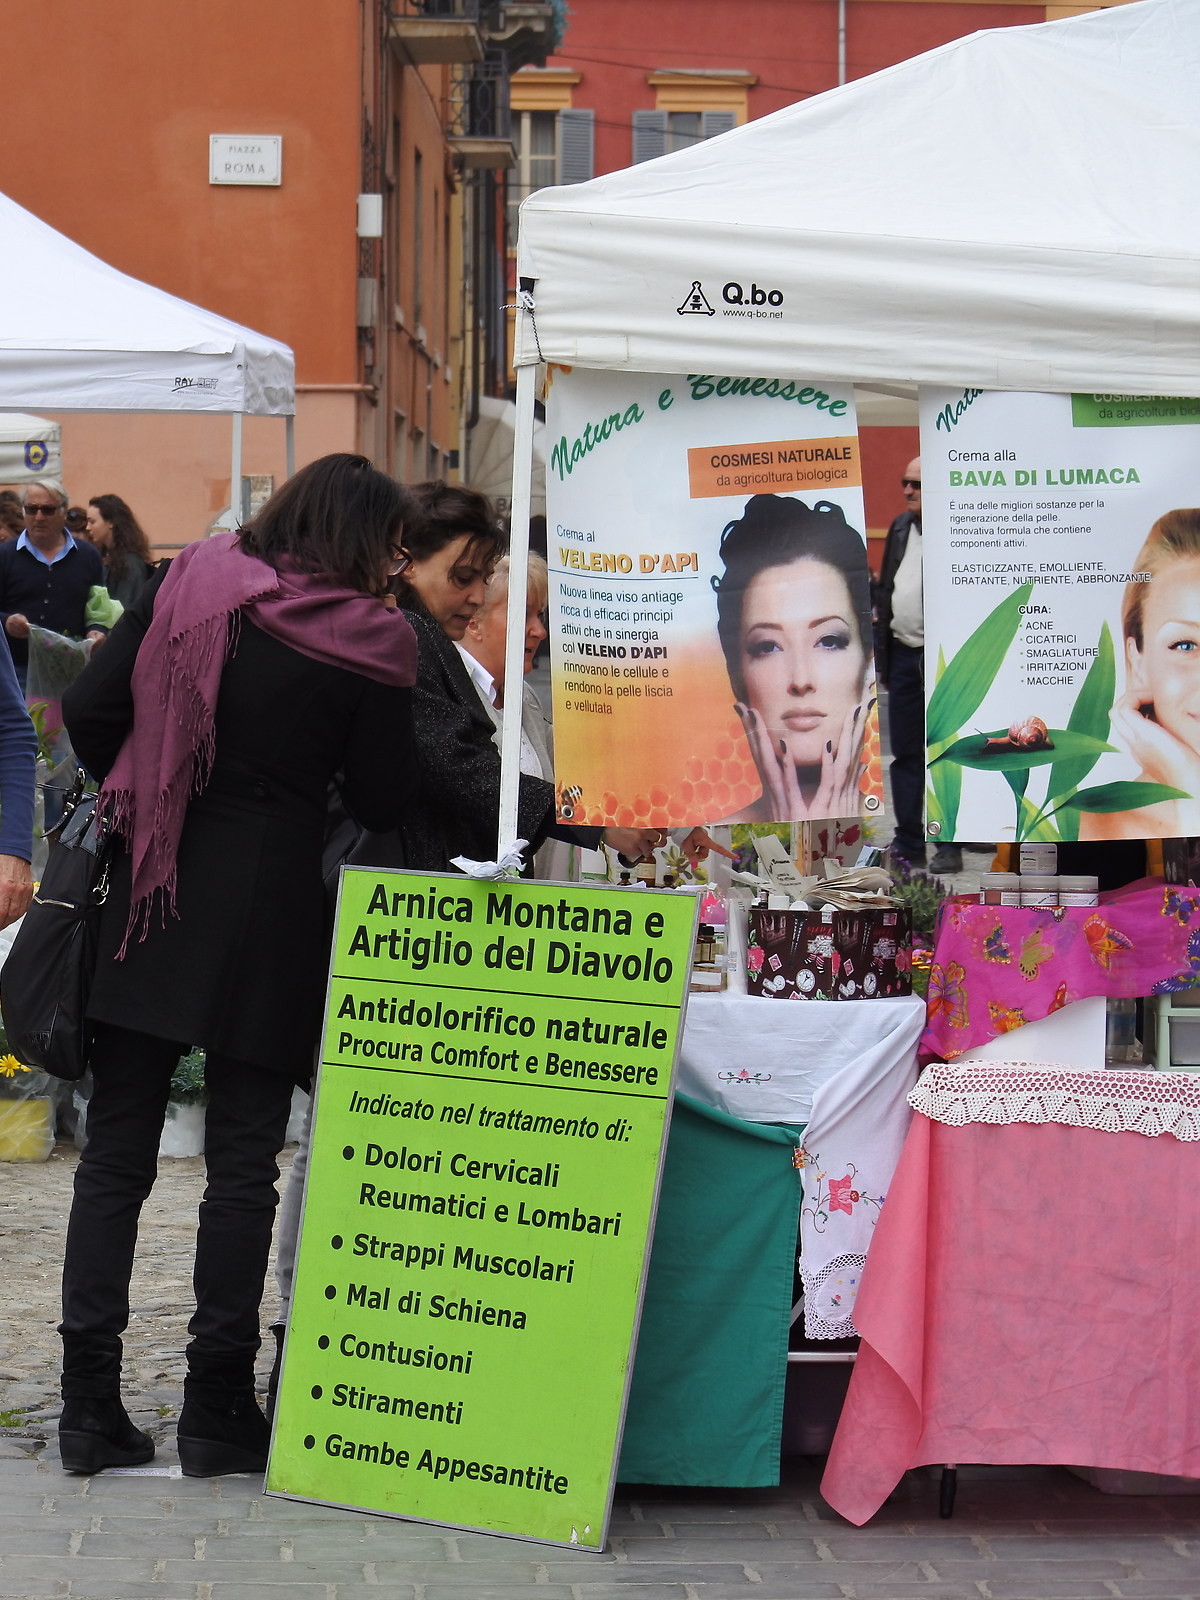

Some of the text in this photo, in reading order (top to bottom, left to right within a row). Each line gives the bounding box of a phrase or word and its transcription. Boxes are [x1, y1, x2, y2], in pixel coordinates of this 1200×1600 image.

[224, 163, 265, 174] ROMA
[722, 282, 784, 306] Q.bo
[723, 310, 783, 319] www.q-bo.net
[175, 377, 194, 387] RAY
[1099, 408, 1113, 419] da
[1116, 407, 1176, 420] agricoltura
[551, 374, 847, 481] Natura e Benessere
[711, 447, 852, 468] COSMESI NATURALE
[948, 449, 1017, 462] Crema alla
[716, 467, 848, 486] da agricoltura biologica
[949, 468, 1141, 487] BAVA DI LUMACA
[977, 501, 998, 510] delle
[1000, 501, 1033, 512] migliori
[1036, 501, 1077, 510] sostanze
[1079, 501, 1094, 511] per
[1096, 500, 1105, 508] la
[950, 513, 1060, 524] rigenerazione della pelle.
[556, 524, 595, 542] Crema al
[950, 525, 1092, 535] Innovativa formula che contiene
[950, 539, 1028, 549] componenti attivi.
[559, 547, 633, 574] VELENO
[951, 562, 1106, 574] ELASTICIZZANTE, EMOLLIENTE,
[951, 573, 1153, 586] IDRATANTE, NUTRIENTE, ABBRONZANTE.
[560, 583, 684, 605] Nuova linea viso antiage
[560, 603, 673, 624] ricca di efficaci principi
[1018, 605, 1051, 615] CURA:
[561, 622, 659, 643] attivi che in sinergia
[1026, 621, 1053, 630] ACNE
[1026, 635, 1077, 644] CICATRICI
[562, 641, 575, 654] col
[577, 642, 626, 659] VELENO
[1026, 648, 1099, 658] SMAGLIATURE
[563, 660, 669, 678] rinnovano le cellule e
[1027, 662, 1087, 671] IRRITAZIONI
[564, 680, 673, 700] rendono la pelle liscia
[1027, 676, 1073, 686] MACCHIE
[565, 700, 613, 715] e vellutata
[367, 884, 664, 938] Arnica Montana e
[348, 925, 672, 983] Artiglio del Diavolo
[337, 994, 667, 1049] Antidolorifico naturale
[339, 1032, 657, 1085] Procura Comfort e Benessere
[349, 1091, 632, 1141] Indicato nel trattamento di:
[365, 1144, 559, 1187] Dolori Cervicali
[360, 1183, 621, 1236] Reumatici e Lombari
[353, 1234, 574, 1283] Strappi Muscolari
[347, 1284, 526, 1329] Mal di Schiena
[340, 1334, 472, 1374] Contusioni
[332, 1384, 463, 1424] Stiramenti
[326, 1434, 568, 1494] Gambe Appesantite
